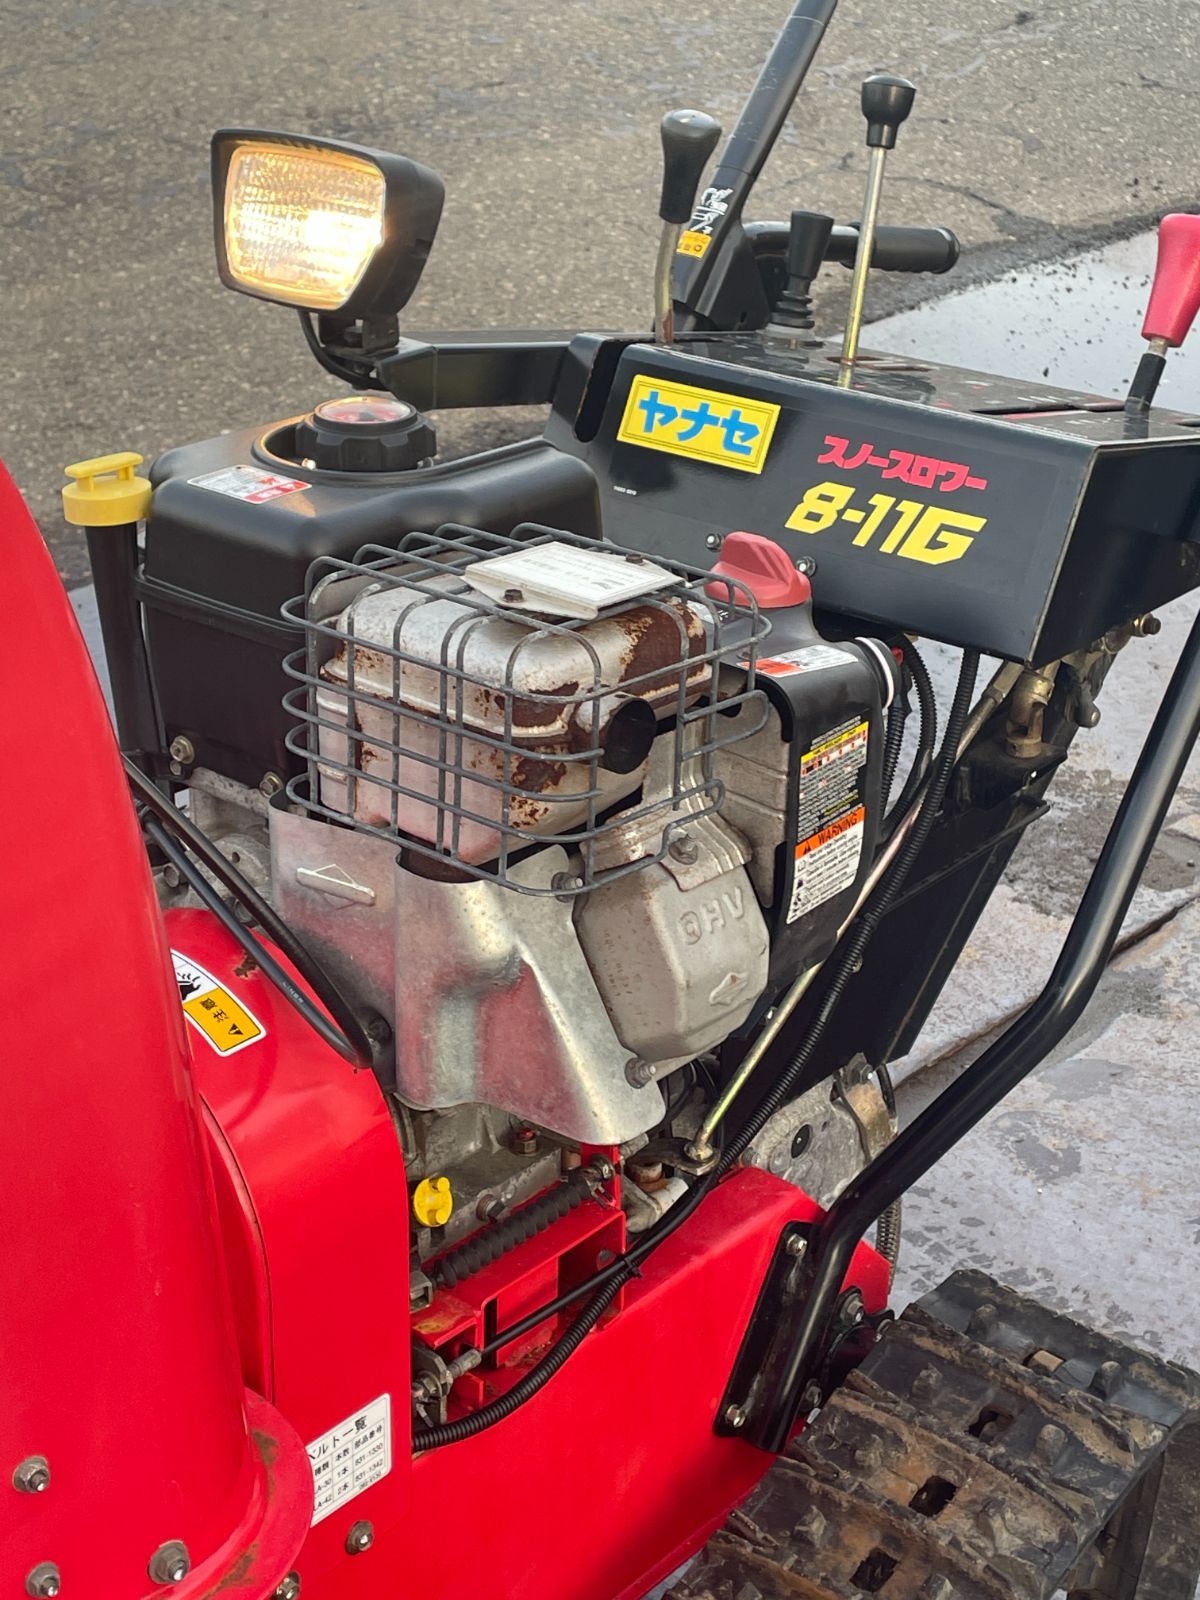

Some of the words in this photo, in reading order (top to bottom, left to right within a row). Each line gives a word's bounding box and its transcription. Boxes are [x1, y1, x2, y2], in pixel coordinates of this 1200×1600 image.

[638, 390, 760, 456] ヤナセ
[817, 434, 989, 492] スノースロワー
[784, 481, 988, 566] 8-11G
[817, 810, 858, 846] WARNING
[678, 885, 746, 946] OHV
[200, 997, 229, 1023] 注意
